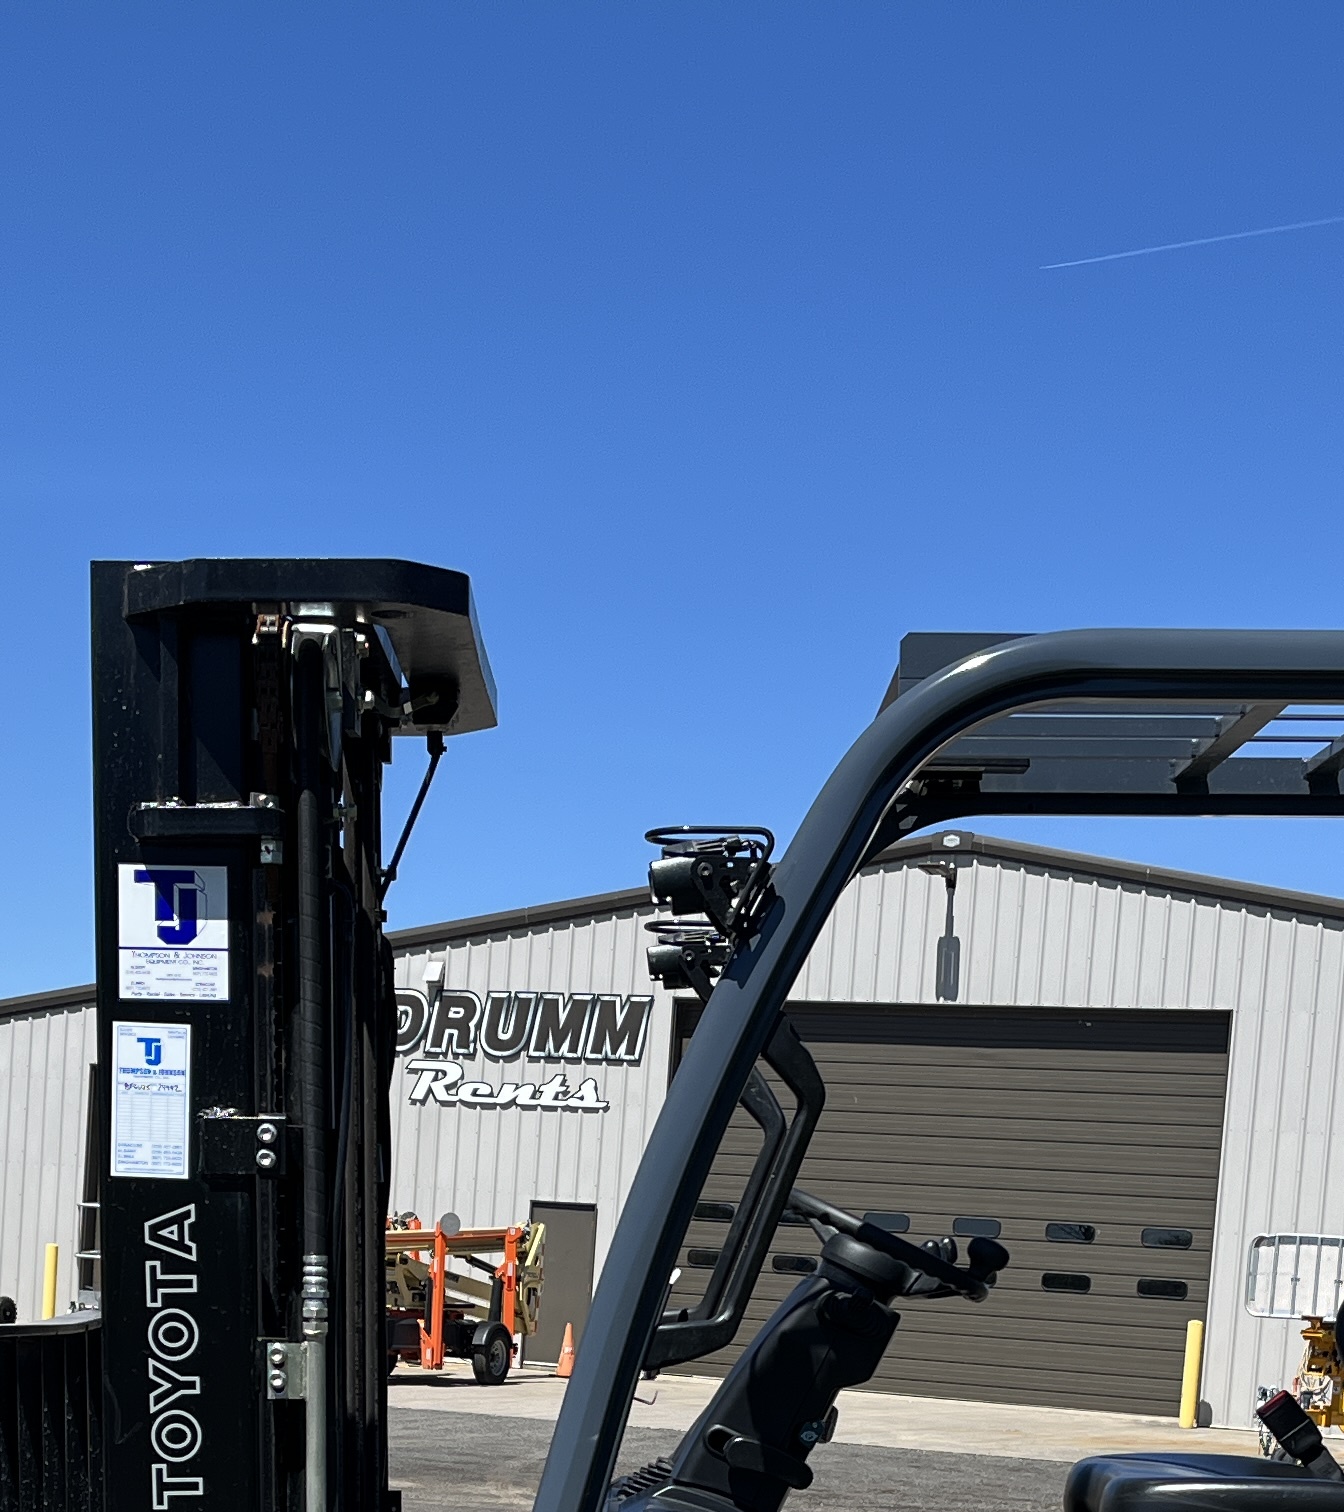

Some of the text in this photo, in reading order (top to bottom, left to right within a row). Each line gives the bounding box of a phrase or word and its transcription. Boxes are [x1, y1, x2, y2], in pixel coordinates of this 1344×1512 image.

[137, 1038, 162, 1066] TJ
[406, 1059, 609, 1109] Rents
[144, 1203, 204, 1511] TOYOTA
